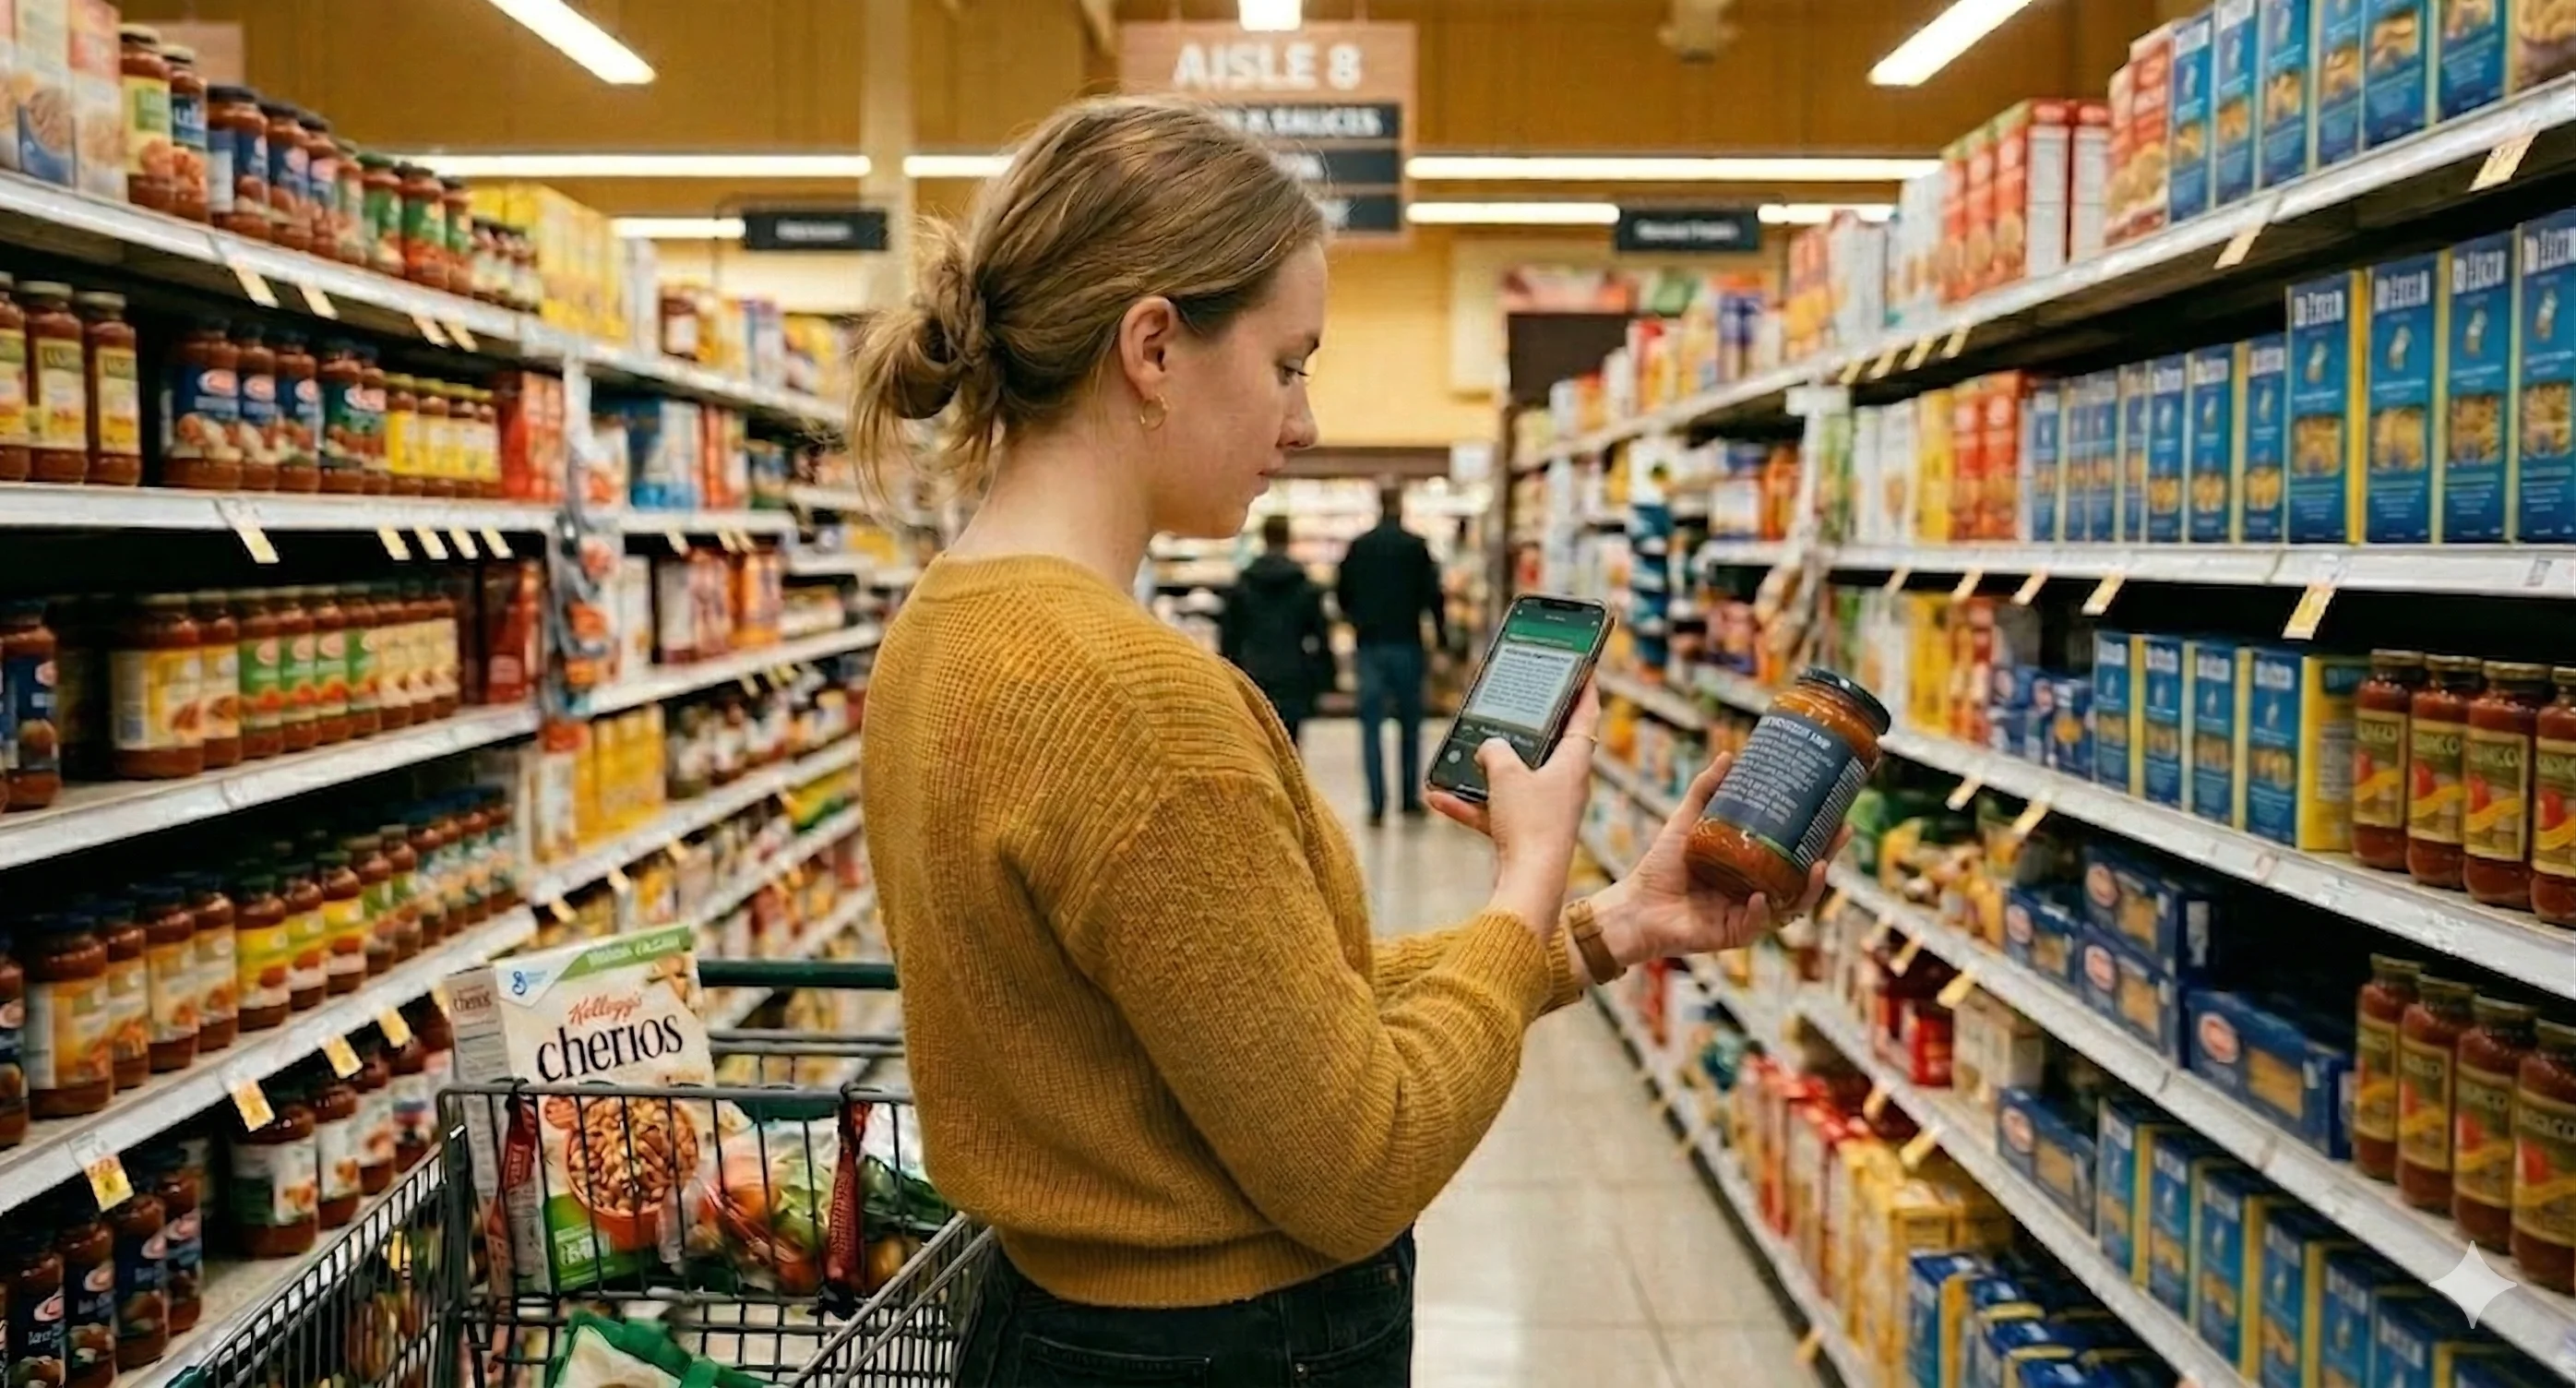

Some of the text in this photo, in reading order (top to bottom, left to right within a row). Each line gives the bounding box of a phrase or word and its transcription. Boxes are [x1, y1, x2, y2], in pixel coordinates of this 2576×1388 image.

[1174, 43, 1362, 90] AISLE 8
[568, 992, 642, 1025] Kellogg's
[537, 1014, 683, 1083] cherios
